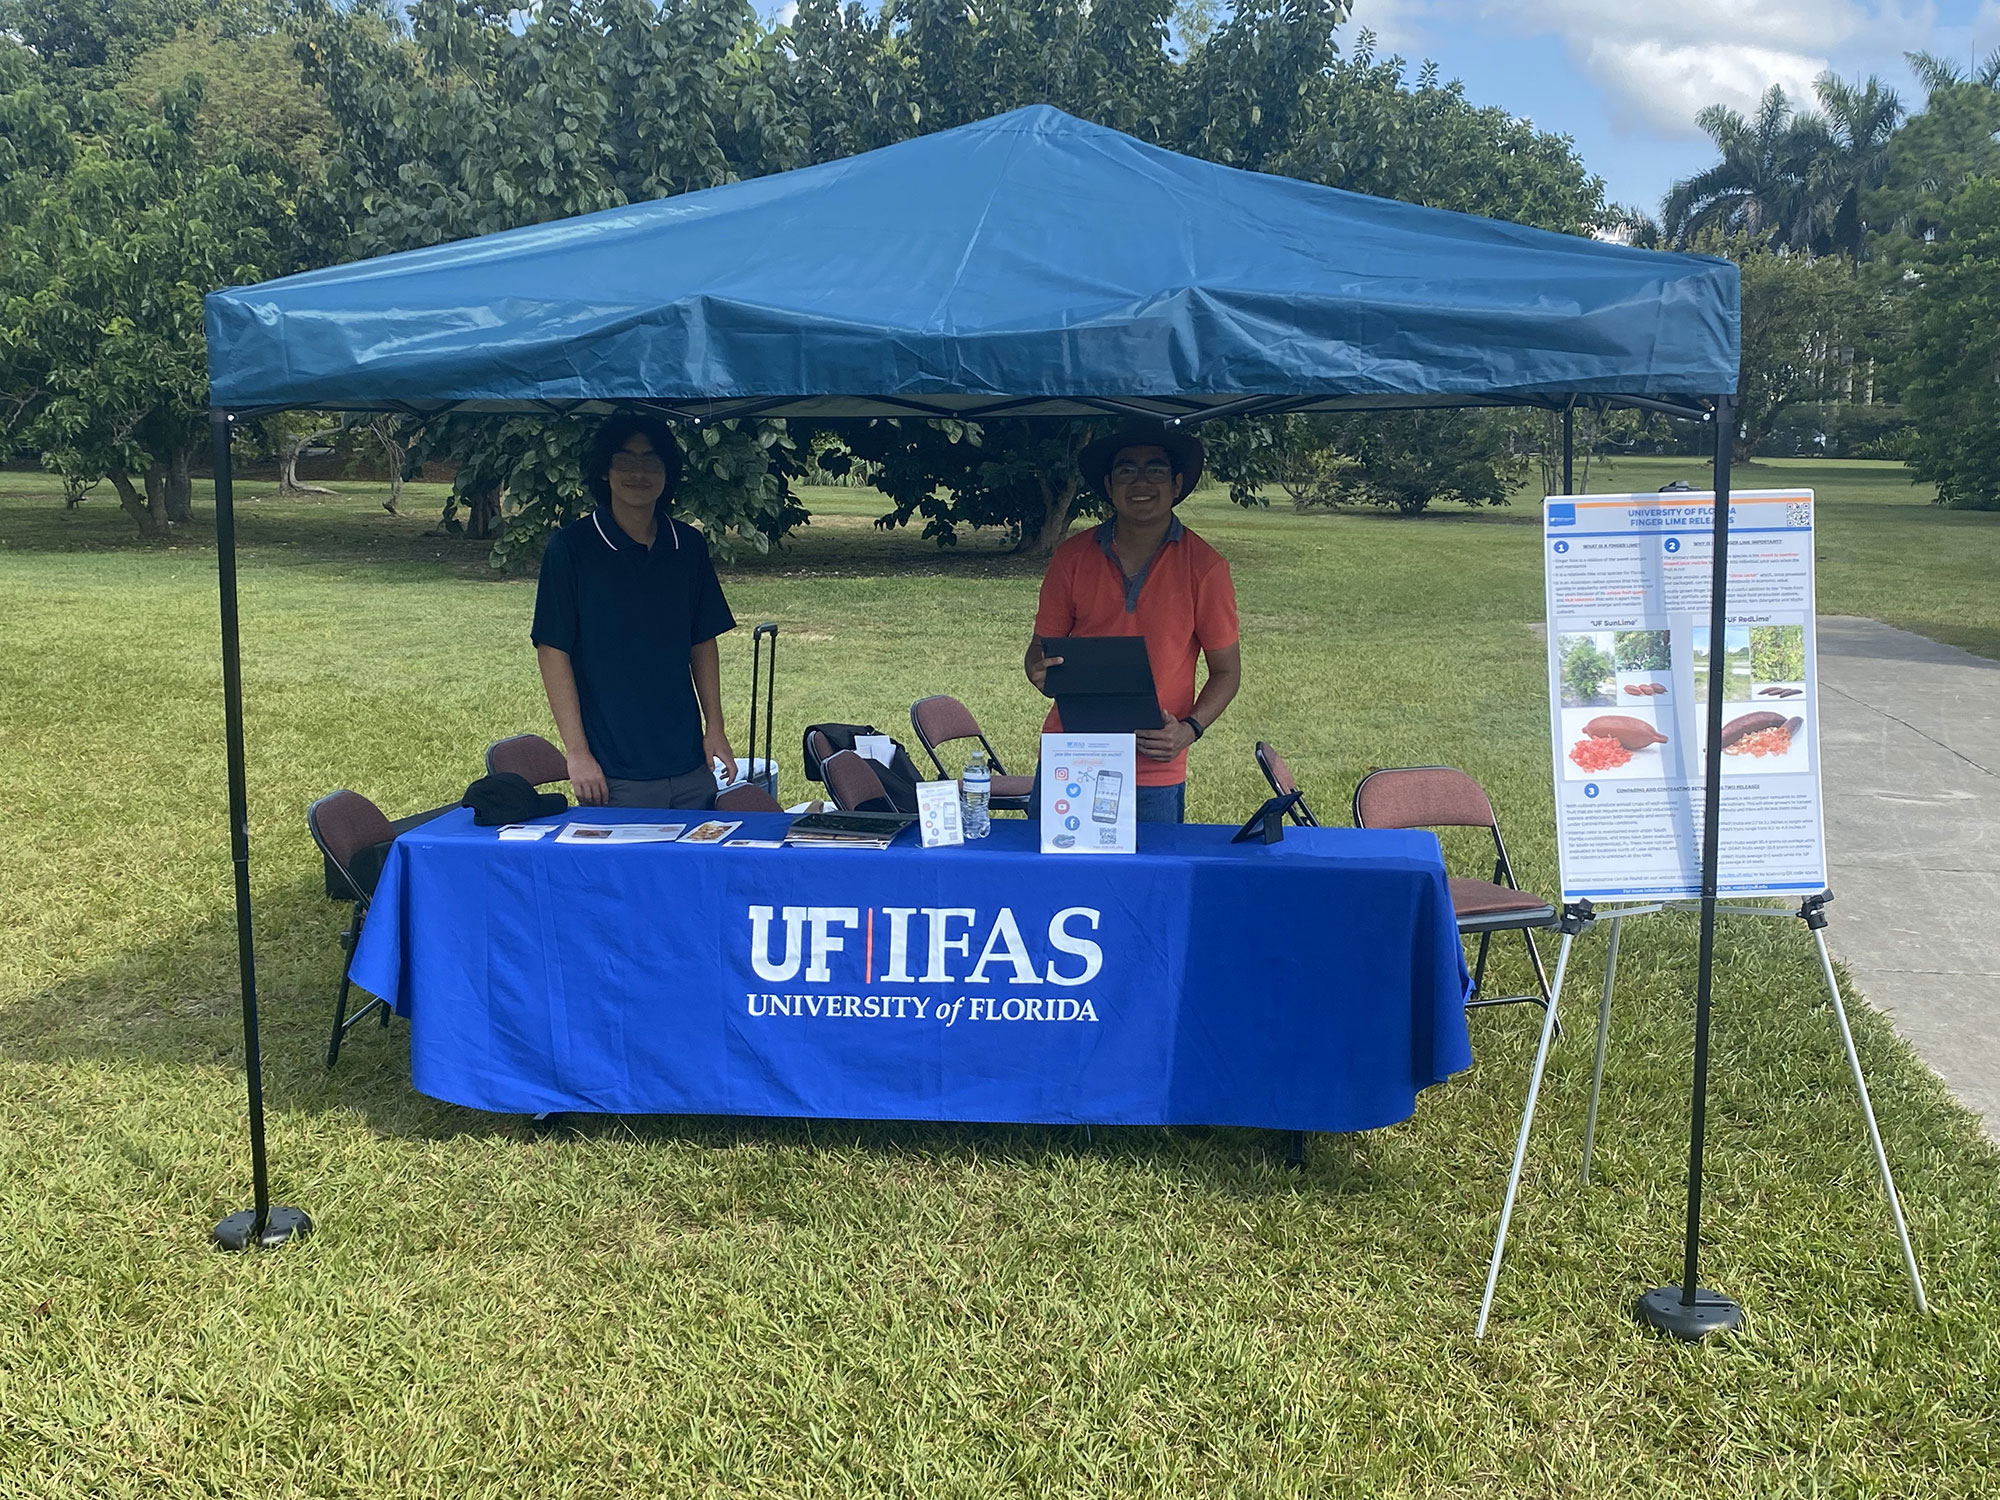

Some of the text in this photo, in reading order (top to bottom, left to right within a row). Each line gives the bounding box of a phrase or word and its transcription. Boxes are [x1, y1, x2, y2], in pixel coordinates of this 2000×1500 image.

[1628, 508, 1682, 517] UNIVERSITY
[1698, 507, 1736, 515] FLOA
[1630, 518, 1663, 526] FINGER
[1666, 517, 1686, 525] LIME
[749, 906, 1104, 986] UF IFAS
[746, 993, 1100, 1026] UNIVERSITY of FLORIDA
